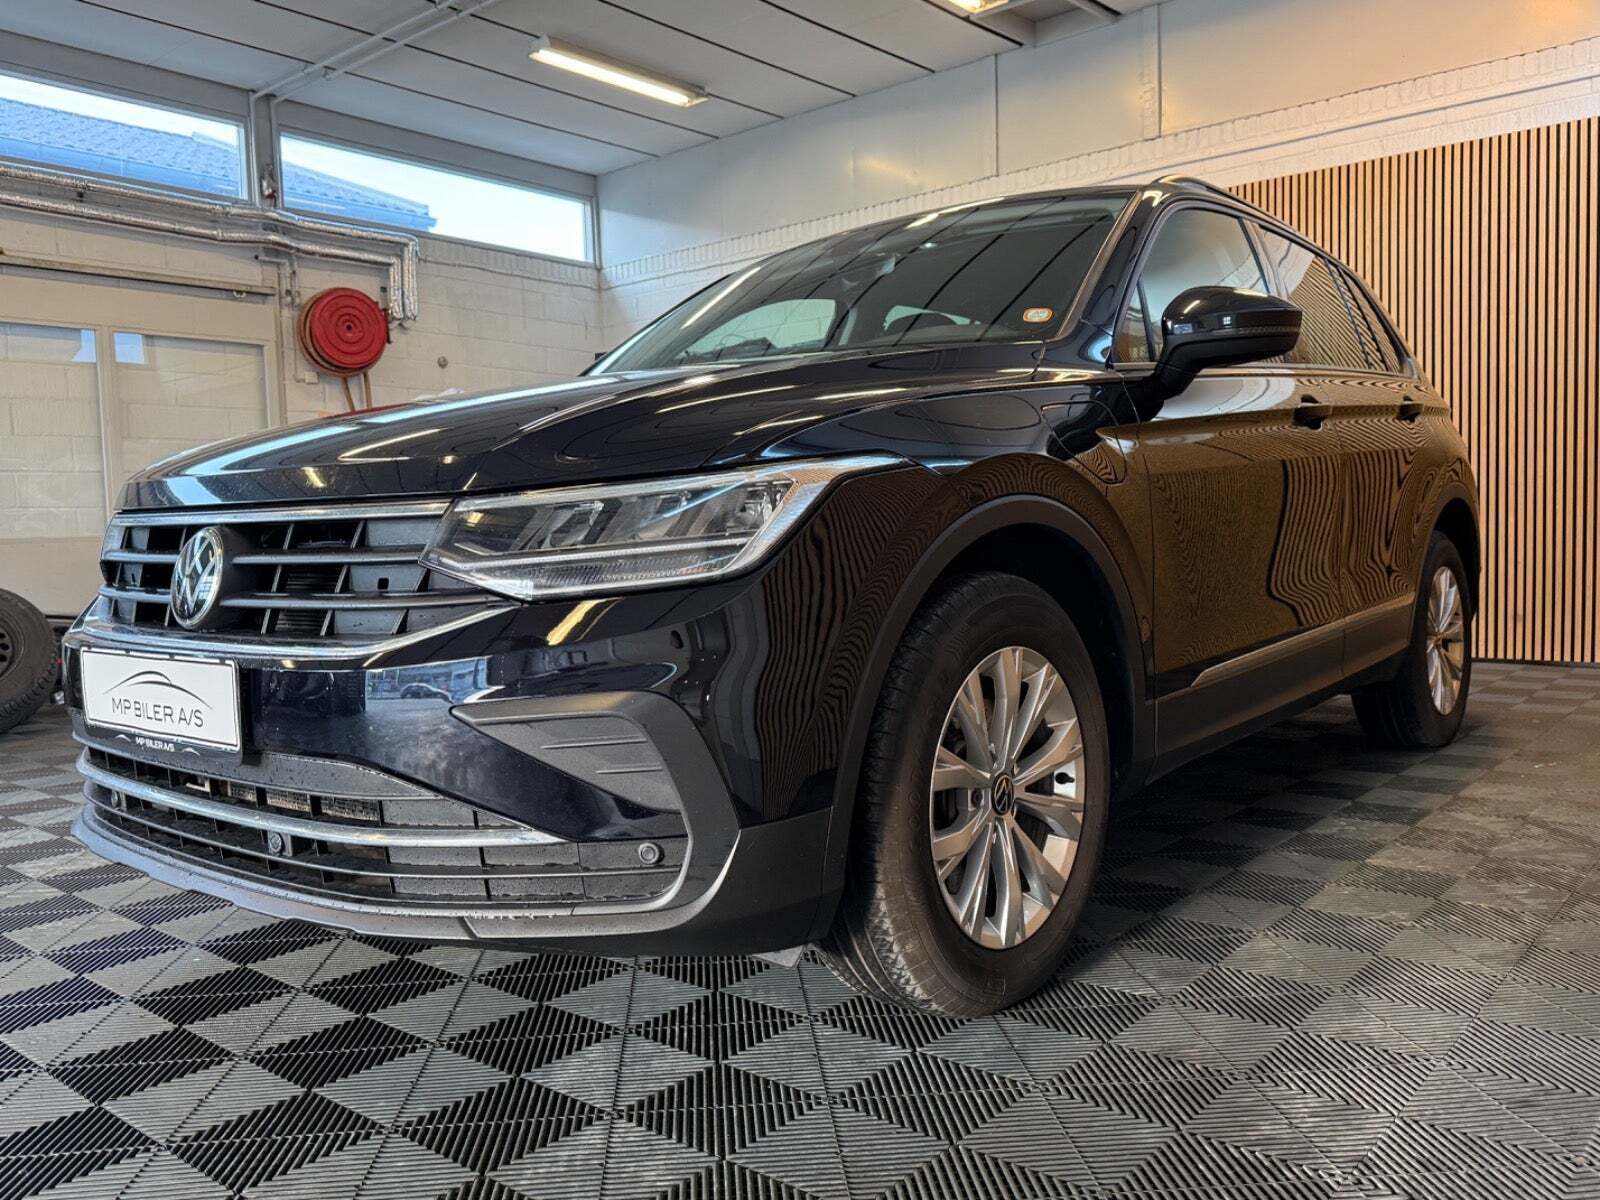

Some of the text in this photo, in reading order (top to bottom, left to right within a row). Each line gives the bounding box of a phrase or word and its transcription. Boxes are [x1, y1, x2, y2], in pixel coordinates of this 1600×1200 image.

[111, 697, 204, 728] MP BILER A/S
[136, 736, 145, 746] MP
